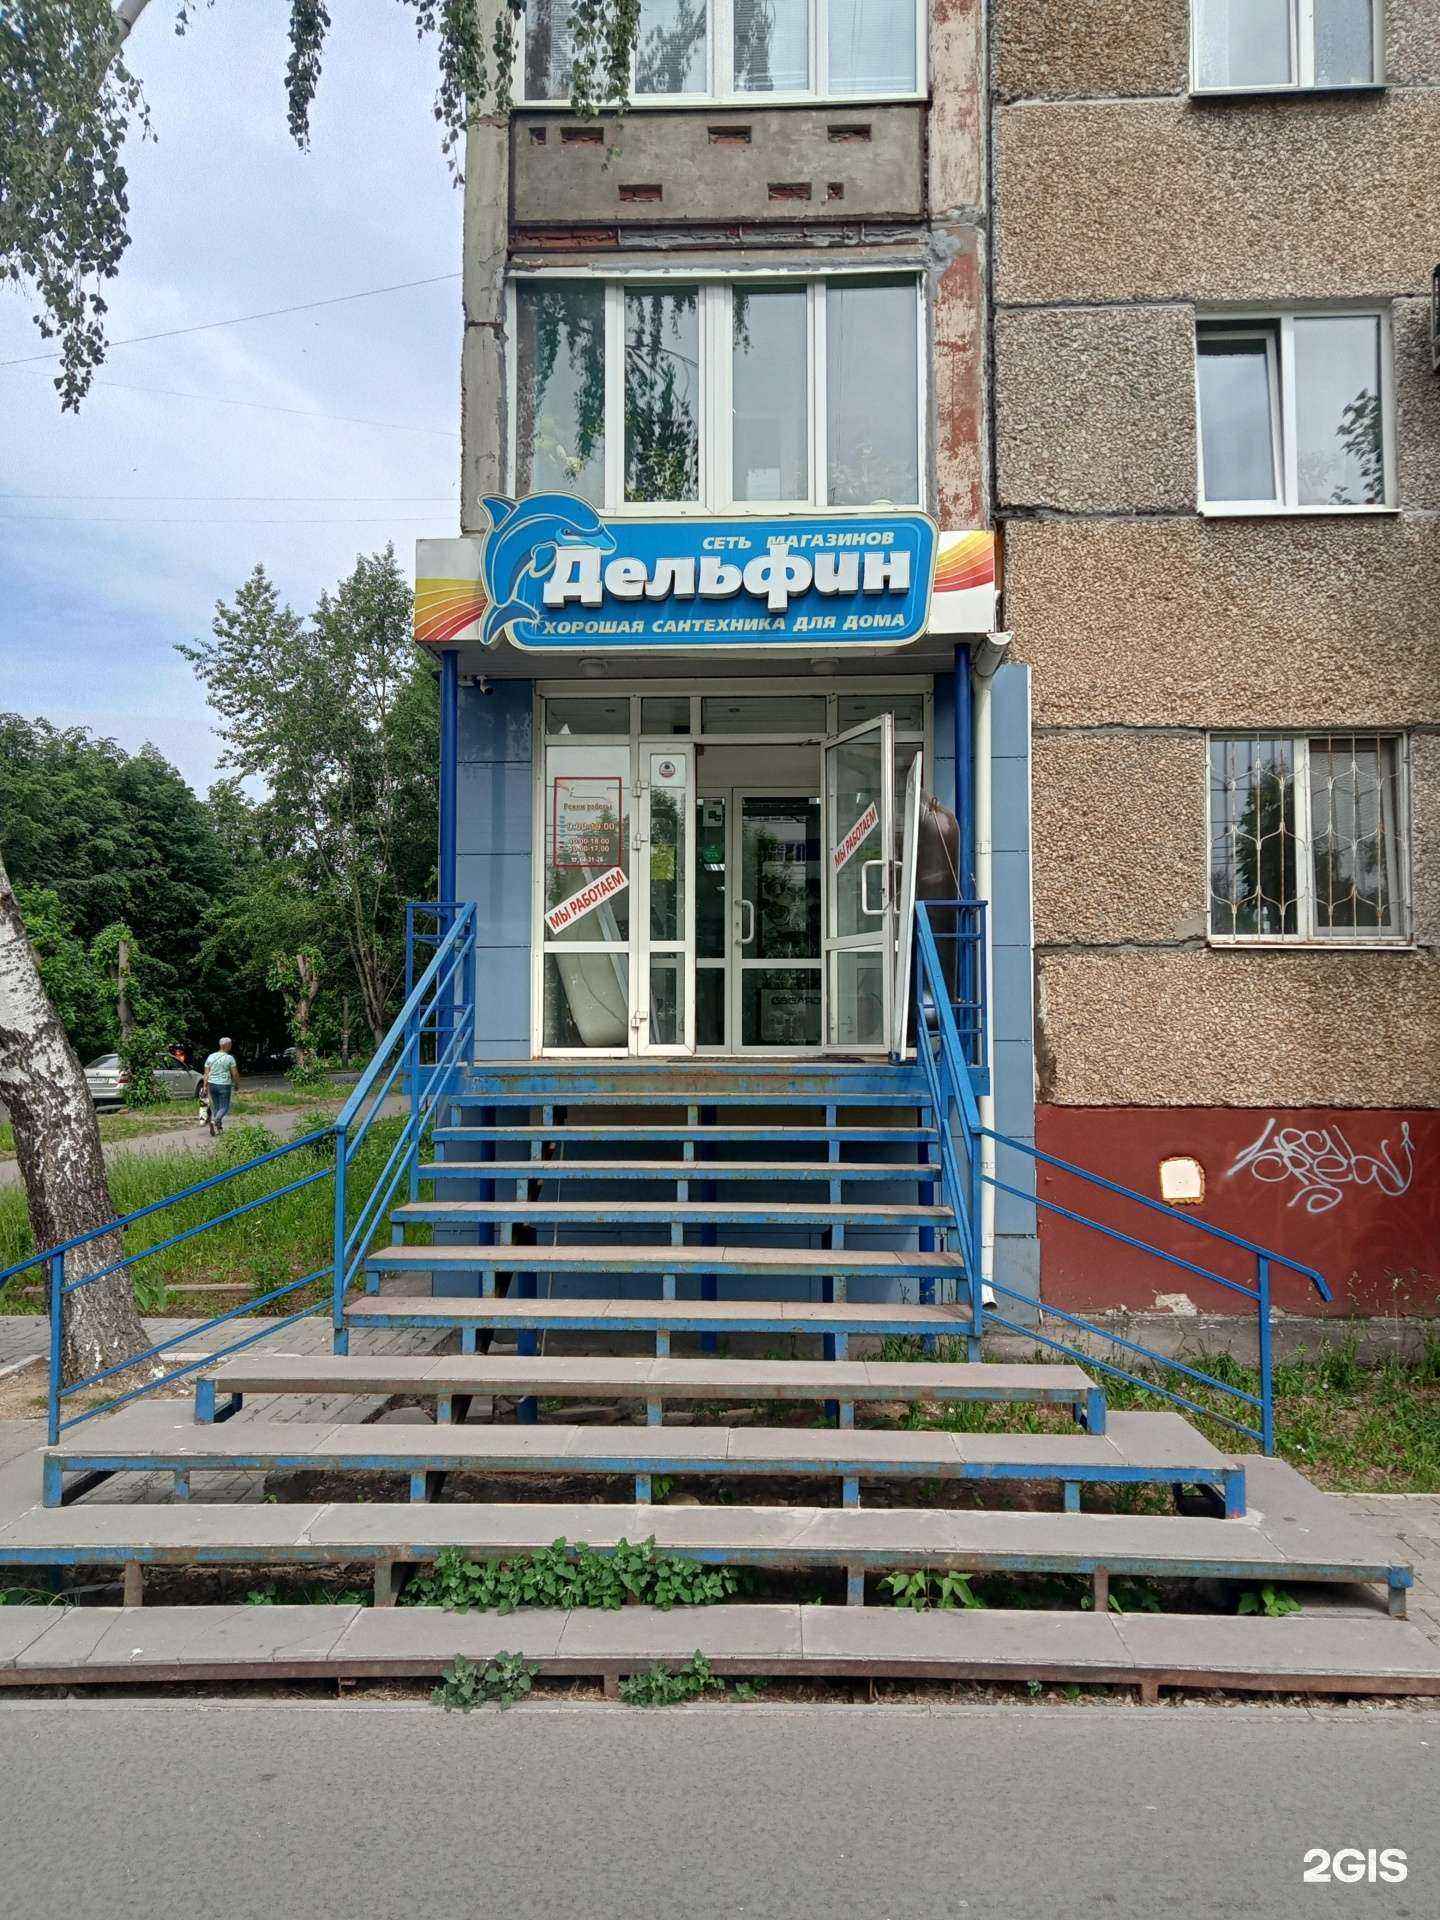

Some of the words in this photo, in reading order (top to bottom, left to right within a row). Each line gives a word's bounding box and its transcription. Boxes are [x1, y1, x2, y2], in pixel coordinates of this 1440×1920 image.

[702, 536, 752, 550] СЕТЬ
[766, 532, 895, 549] МАГАЗИНОВ
[542, 543, 911, 612] Дельфин
[542, 620, 644, 634] ХОРОШАЯ
[651, 617, 787, 633] САНТЕХНИКА
[792, 615, 836, 632] ДЛЯ
[842, 613, 905, 631] ДОМА
[845, 807, 877, 854] РАБОТАЕМ
[549, 906, 572, 930] МЫ
[569, 870, 625, 916] РАБОТАЕМ
